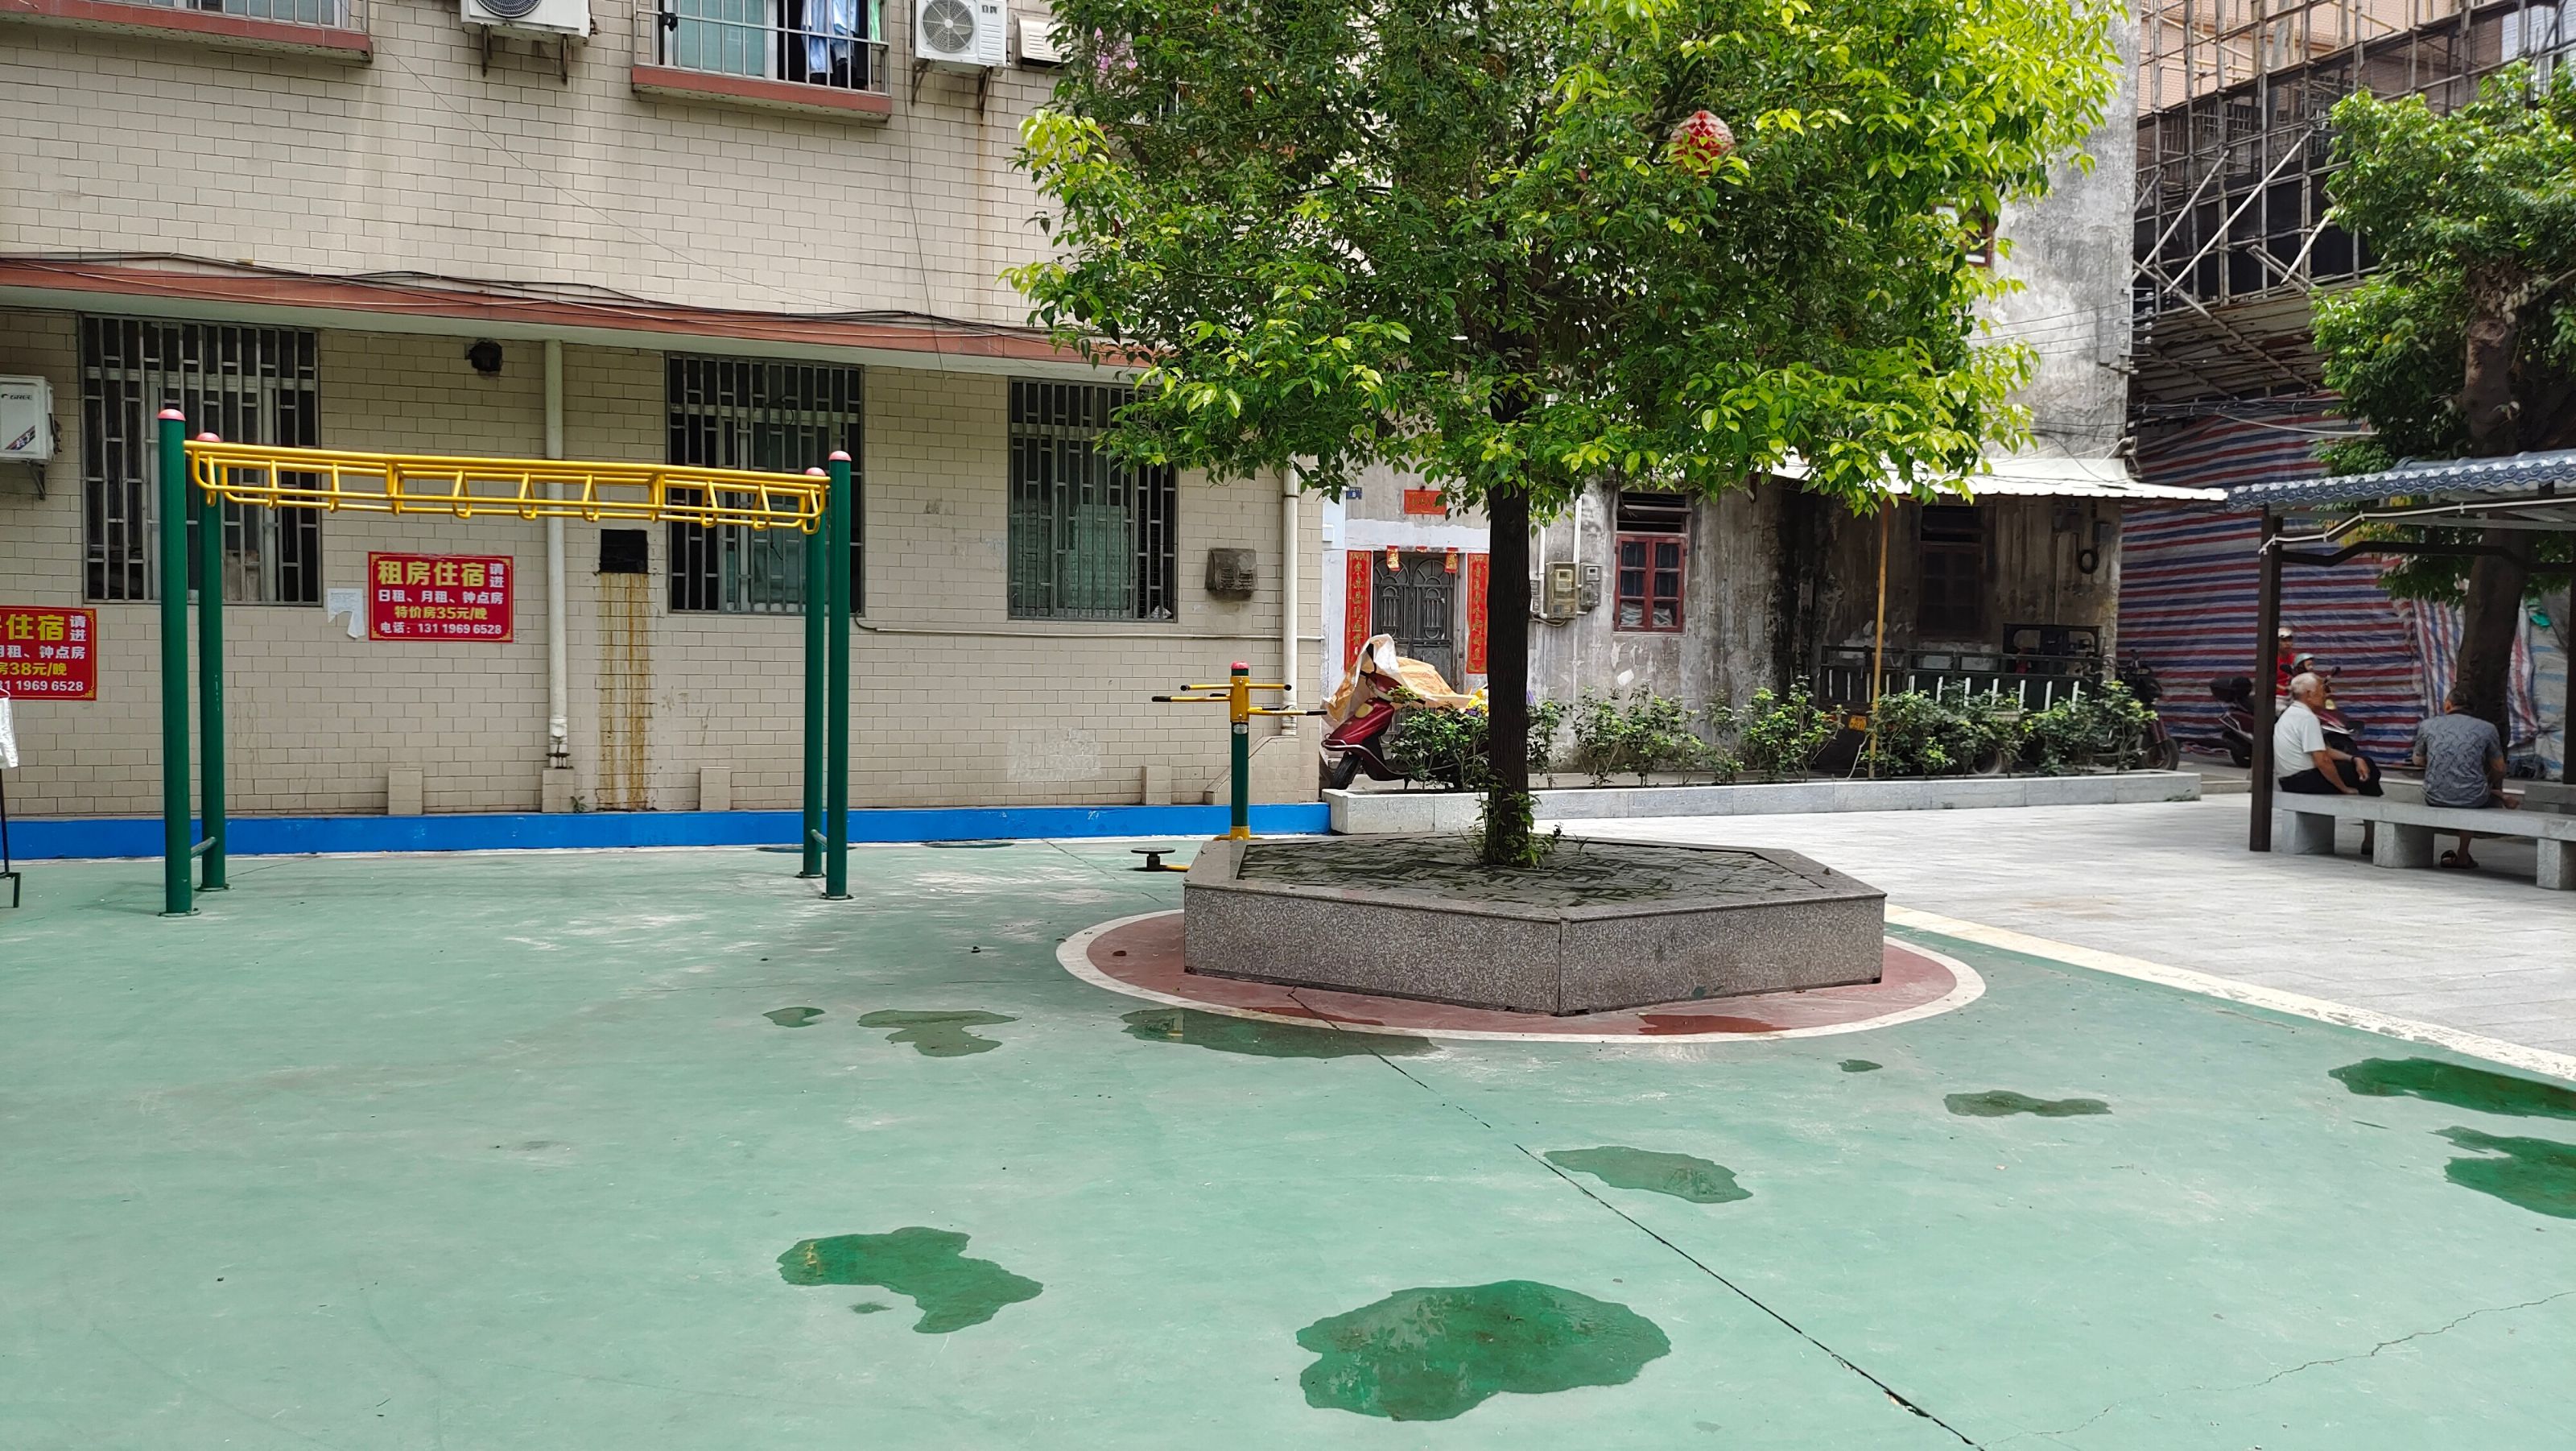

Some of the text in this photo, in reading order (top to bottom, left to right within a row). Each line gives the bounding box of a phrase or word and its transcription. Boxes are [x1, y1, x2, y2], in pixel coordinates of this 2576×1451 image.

[378, 560, 485, 587] 租房住宿
[489, 563, 505, 588] 请进
[378, 589, 504, 605] 日租、月租、钟点房
[394, 606, 488, 620] 特价房35元/晚
[0, 614, 64, 641] 住宿
[69, 615, 86, 642] 请进
[418, 623, 439, 633] 131
[443, 623, 470, 635] 1969
[473, 624, 502, 635] 6528
[16, 680, 48, 691] 1969
[52, 680, 84, 692] 6528
